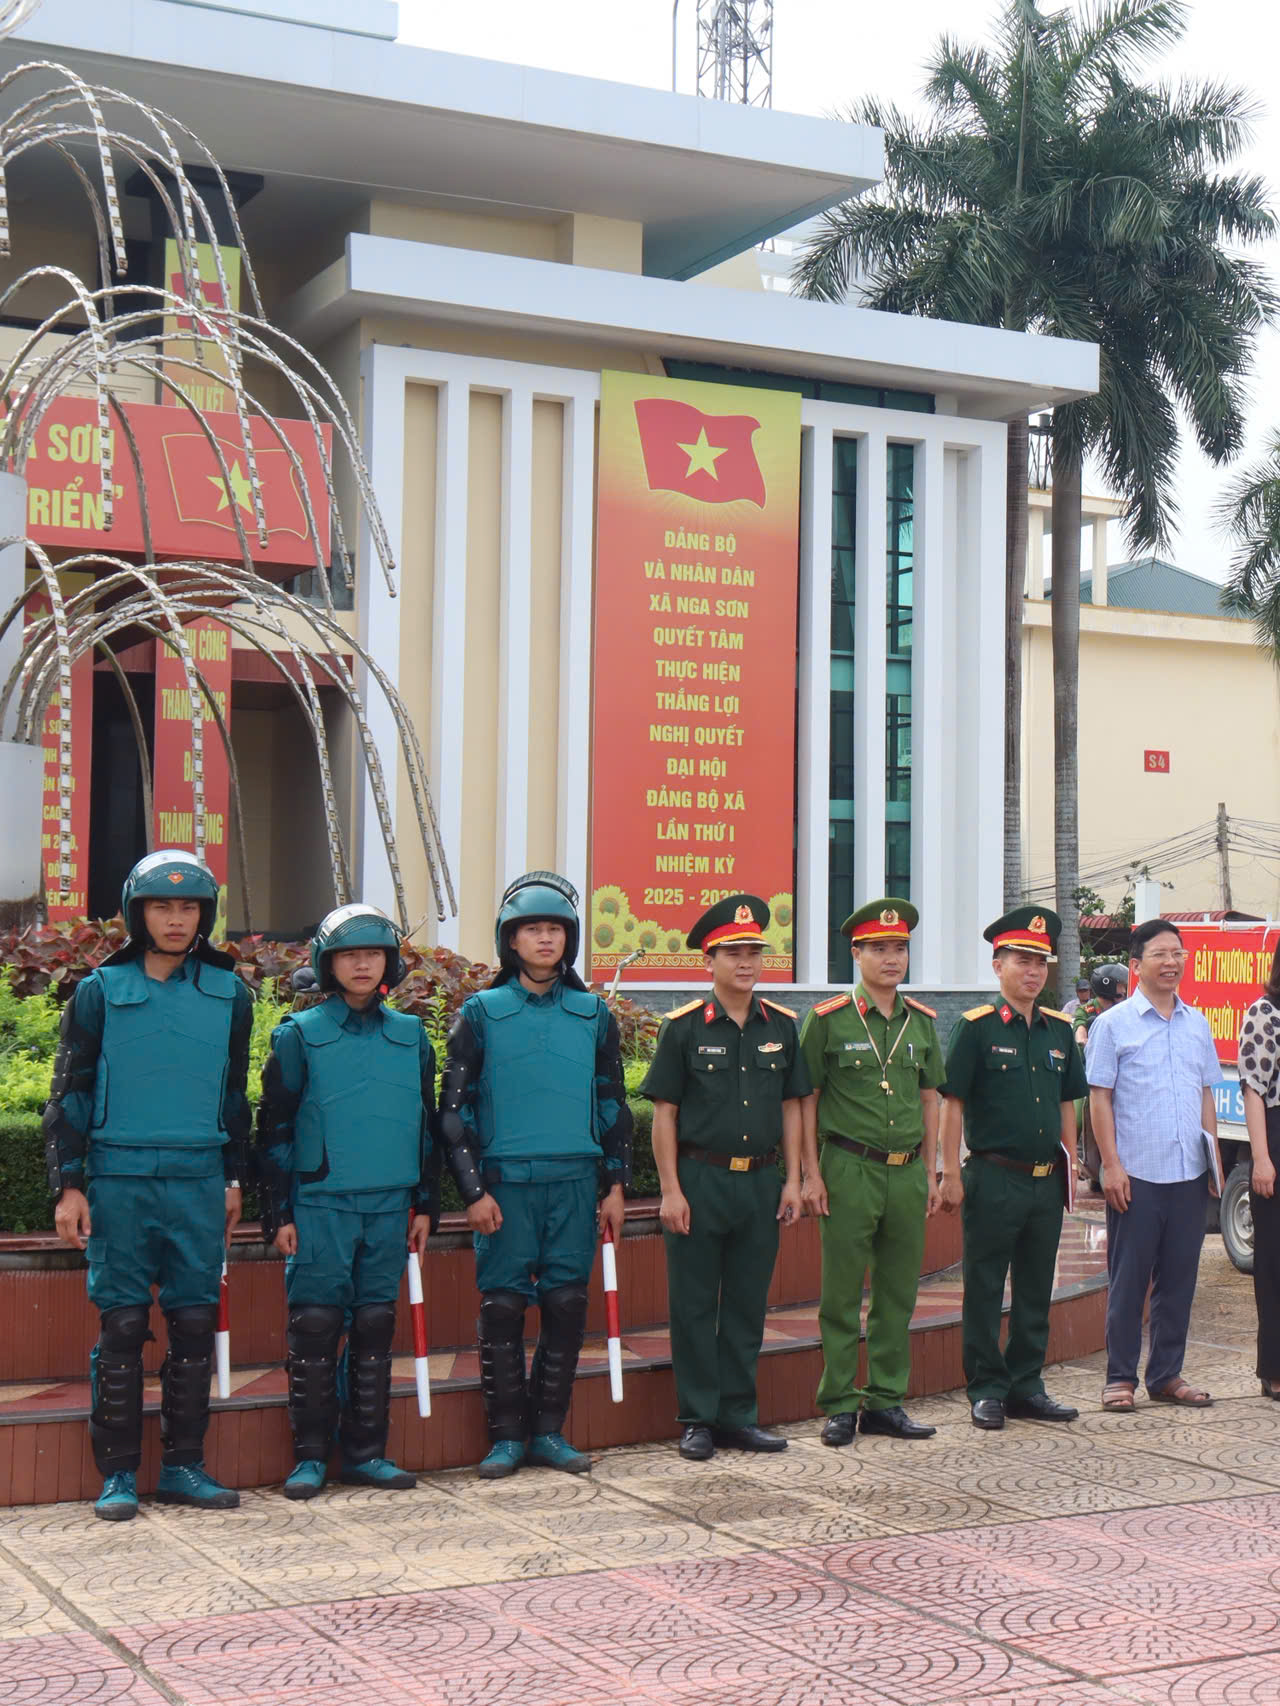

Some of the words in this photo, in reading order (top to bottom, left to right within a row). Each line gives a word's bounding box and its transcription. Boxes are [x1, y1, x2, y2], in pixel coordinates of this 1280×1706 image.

[28, 476, 124, 531] RIỂN”
[664, 526, 710, 552] ĐẢNG
[714, 533, 736, 557] BỘ
[644, 558, 666, 580] VÀ
[670, 562, 716, 584] NHÂN
[721, 566, 755, 587] DÂN
[649, 592, 672, 612] XÃ
[676, 596, 710, 615] NGA
[715, 600, 749, 618] SƠN
[653, 624, 704, 647] QUYẾT
[709, 629, 744, 650] TÂM
[656, 659, 697, 682] THỰC
[702, 661, 741, 684] HIỆN
[656, 688, 710, 712] THẮNG
[714, 696, 739, 717] LỢI
[649, 724, 689, 747] NGHỊ
[694, 724, 744, 746] QUYẾT
[666, 758, 694, 779] ĐẠI
[700, 757, 727, 781] HỘI
[1148, 754, 1166, 768] S4
[647, 784, 692, 808] ĐẢNG
[697, 789, 719, 812] BỘ
[724, 790, 745, 810] XÃ
[159, 806, 192, 843] THÀNH
[657, 817, 688, 840] LẦN
[694, 822, 727, 842] THỨ
[729, 825, 735, 842] I
[656, 852, 709, 876] NHIỆM
[644, 888, 684, 905] 2025
[1194, 944, 1214, 982] GÂY
[1216, 948, 1254, 984] THƯƠNG
